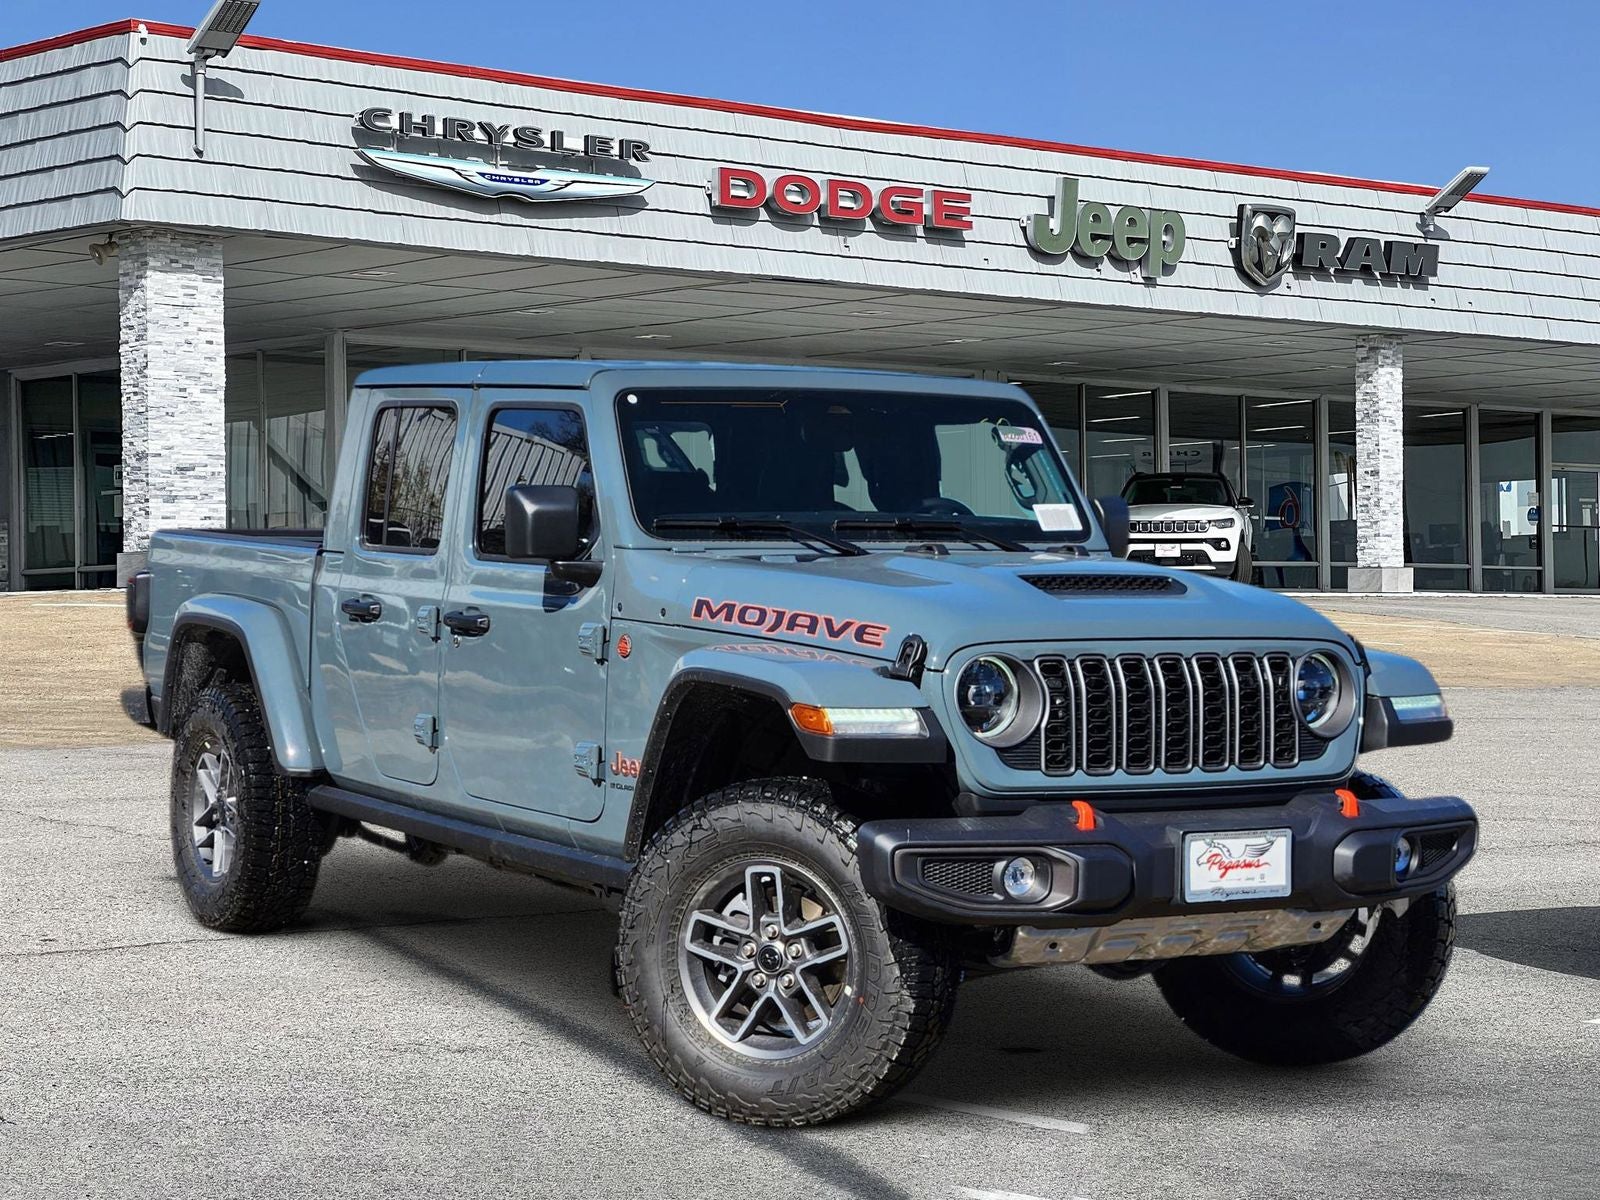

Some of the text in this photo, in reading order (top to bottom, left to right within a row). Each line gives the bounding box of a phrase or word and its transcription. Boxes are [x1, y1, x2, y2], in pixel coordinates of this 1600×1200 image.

[359, 107, 651, 162] CHRYSLER
[484, 174, 541, 185] CHRYSLER
[713, 167, 973, 230] DODGE
[1028, 177, 1186, 278] Jeep
[1300, 232, 1439, 277] RAM
[692, 597, 890, 647] MOJAVE
[611, 751, 641, 778] Jee
[1207, 852, 1271, 879] Pegasus
